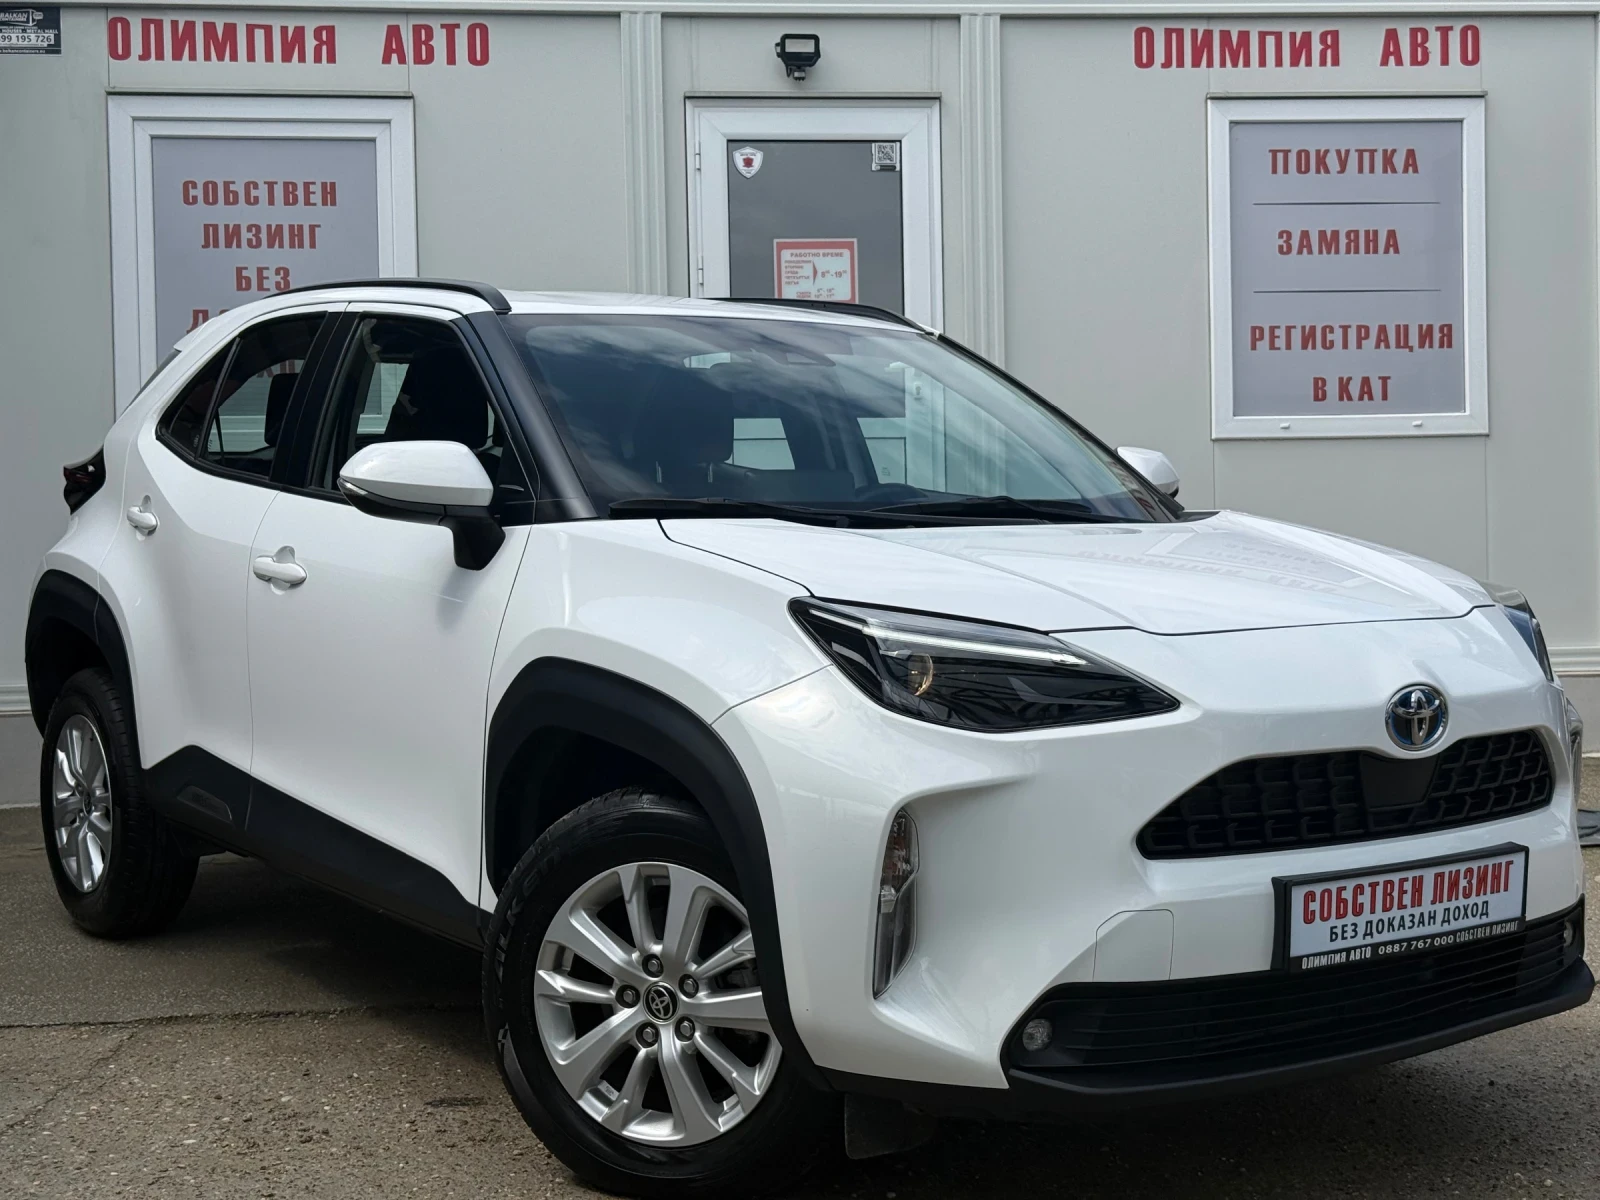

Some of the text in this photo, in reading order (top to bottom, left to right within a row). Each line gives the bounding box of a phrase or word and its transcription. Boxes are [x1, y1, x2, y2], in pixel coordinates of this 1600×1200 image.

[108, 17, 491, 66] ОЛИМПИЯ АВТО
[1133, 24, 1481, 69] ОЛИМПИЯ АВТО
[1268, 149, 1419, 175] ПОКУПКА
[182, 180, 337, 207] СОБСТВЕН
[201, 224, 322, 249] ЛИЗИНГ
[1277, 229, 1400, 255] ЗАМЯНА
[235, 266, 291, 292] БЕЗ
[1250, 323, 1453, 352] РЕГИСТРАЦИЯ
[1313, 376, 1391, 402] В КАТ
[1303, 860, 1514, 925] СОБСТВЕН ЛИЗИНГ
[1329, 900, 1489, 943] БЕЗ ДОКАЗАН ДОХОД
[1302, 920, 1519, 970] ОЛИМПИЯ АВТО 0887 767 000 СОБСТВЕН ЛИЗИНГ
